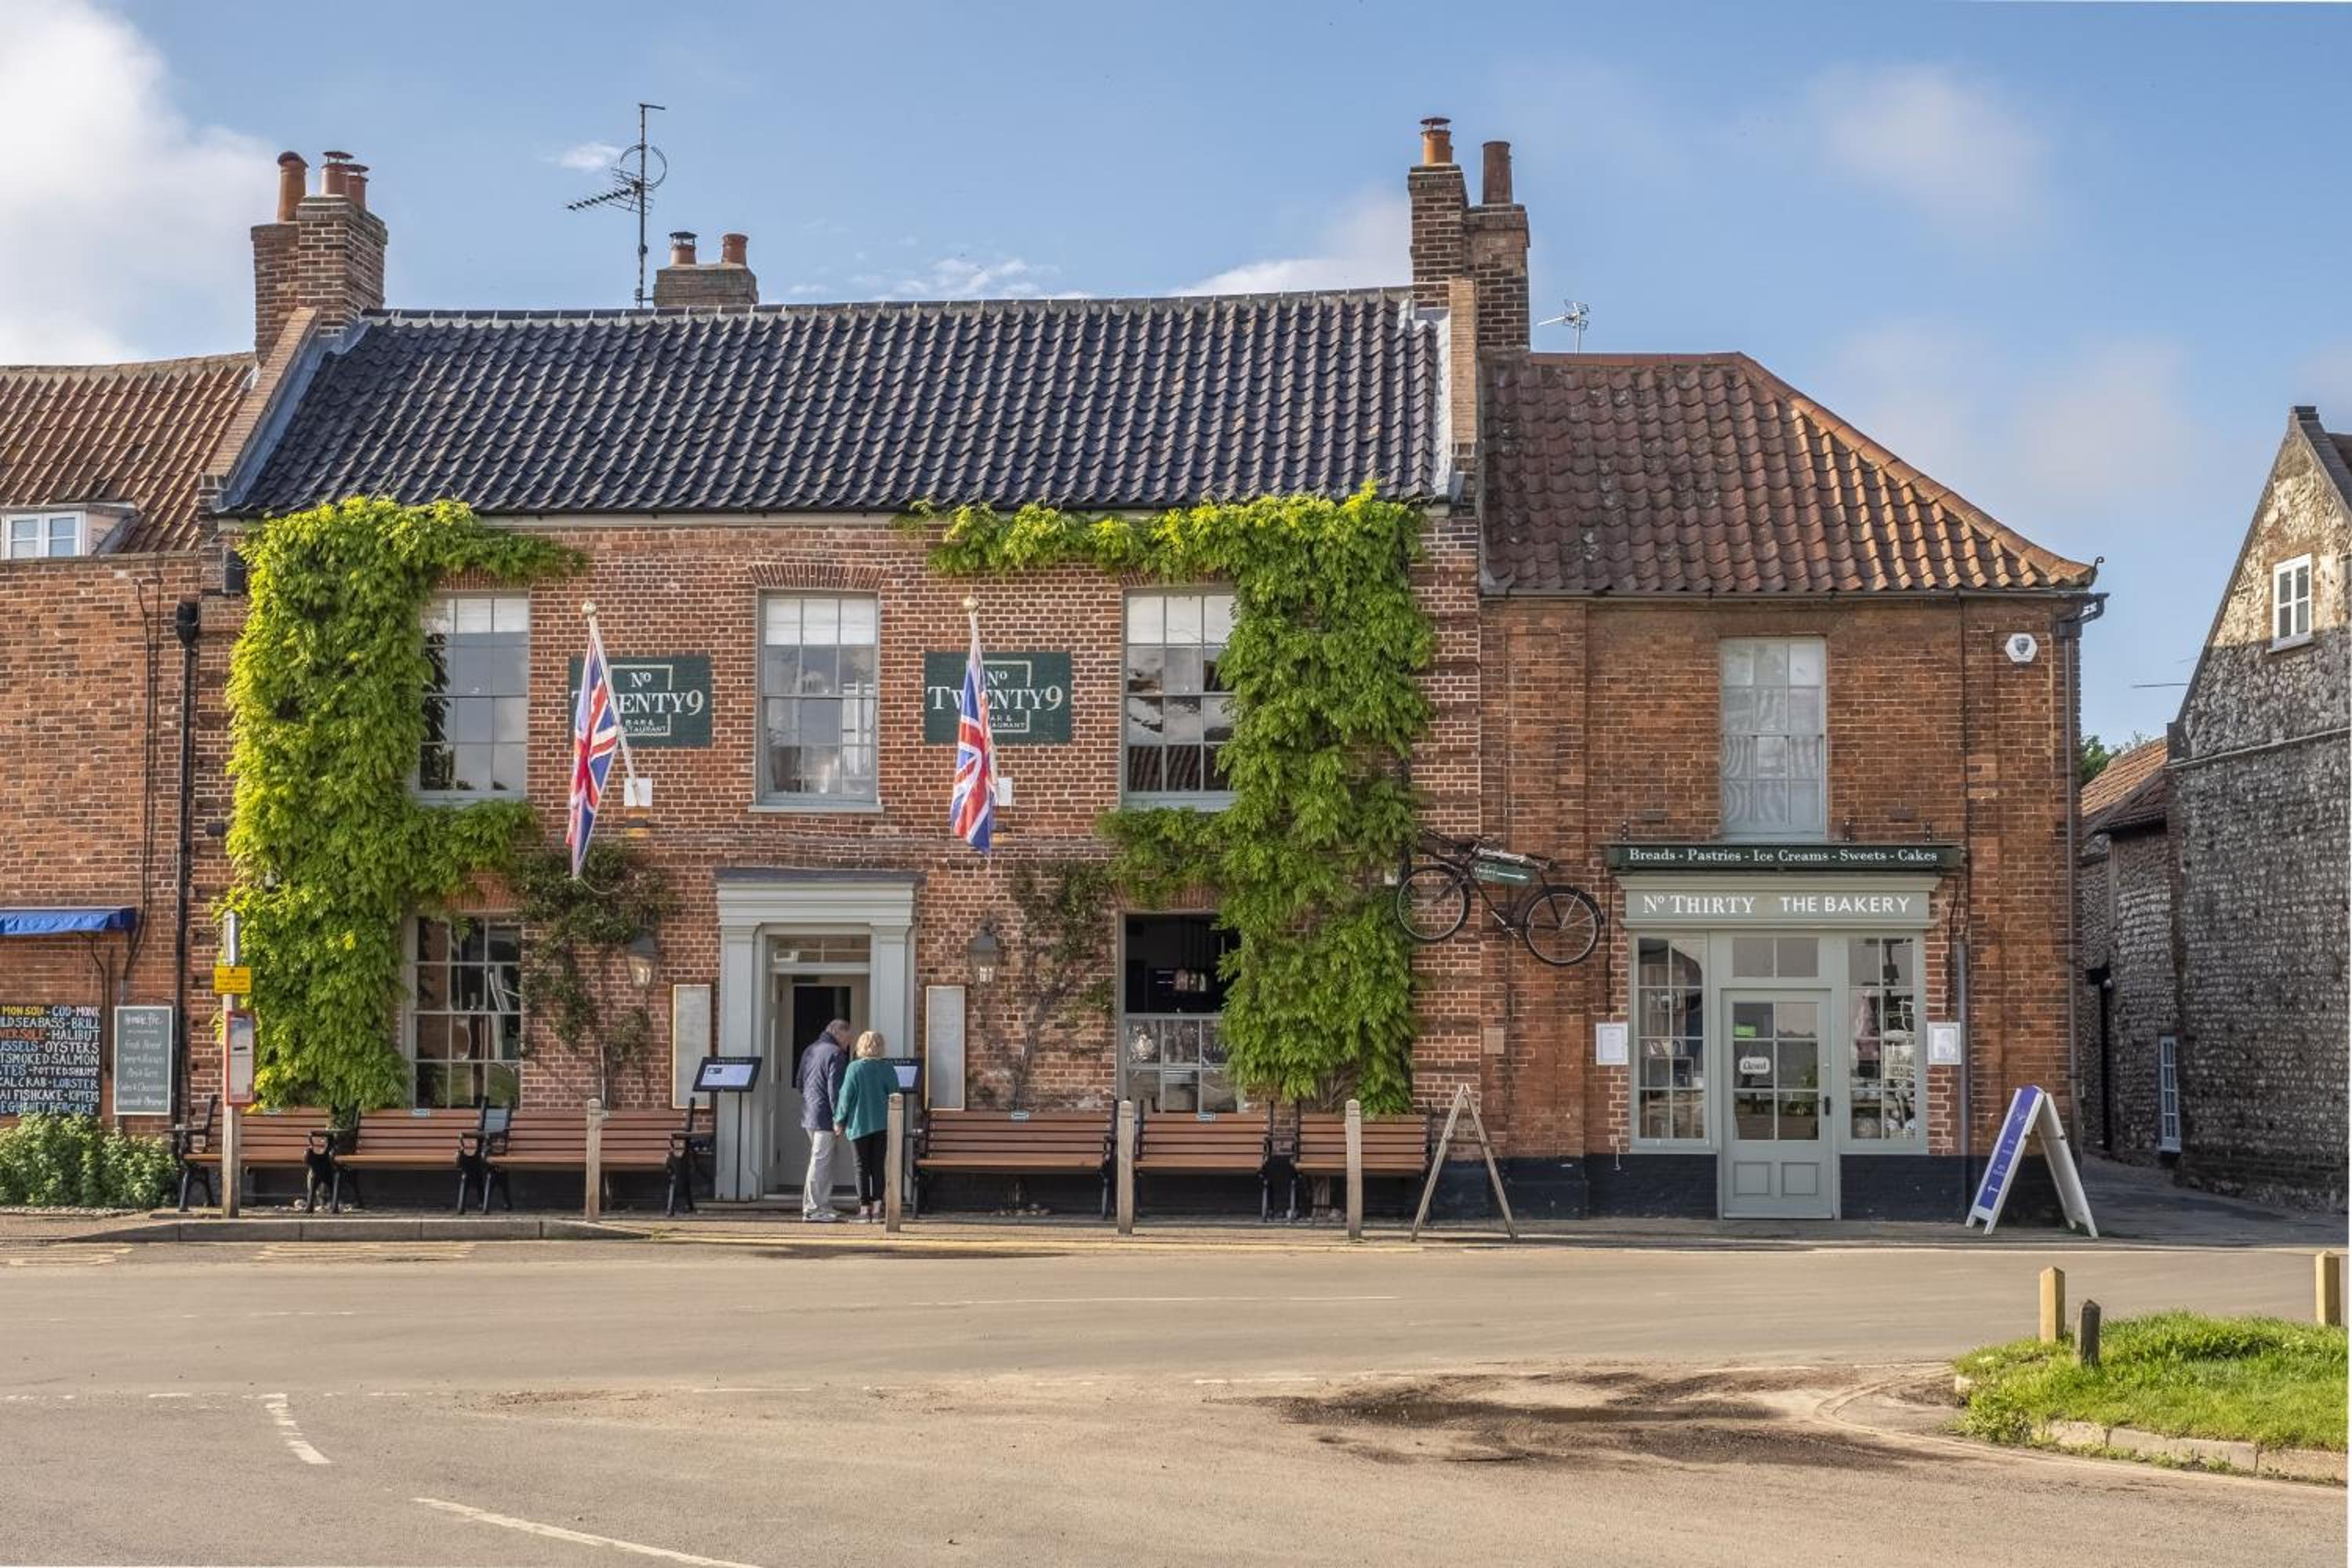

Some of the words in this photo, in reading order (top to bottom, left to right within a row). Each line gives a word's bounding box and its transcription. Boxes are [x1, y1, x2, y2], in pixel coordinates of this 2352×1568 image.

[1630, 848, 1676, 861] Breads
[1688, 849, 1741, 862] Pastries
[1754, 850, 1774, 862] Ice
[1778, 850, 1829, 862] Creams
[1839, 850, 1887, 862] Sweets
[1898, 849, 1937, 862] Cakes
[1670, 895, 1755, 913] THIRTY
[1780, 896, 1817, 913] THE
[1824, 896, 1910, 913] BAKERY
[52, 1006, 72, 1017] COD
[76, 1006, 100, 1018] MONK
[71, 1018, 100, 1029] BRILL
[51, 1029, 100, 1041] HALIBUT
[45, 1041, 100, 1054] OYSTERS
[51, 1053, 100, 1065] SALMON
[53, 1077, 99, 1089] LOBSTER
